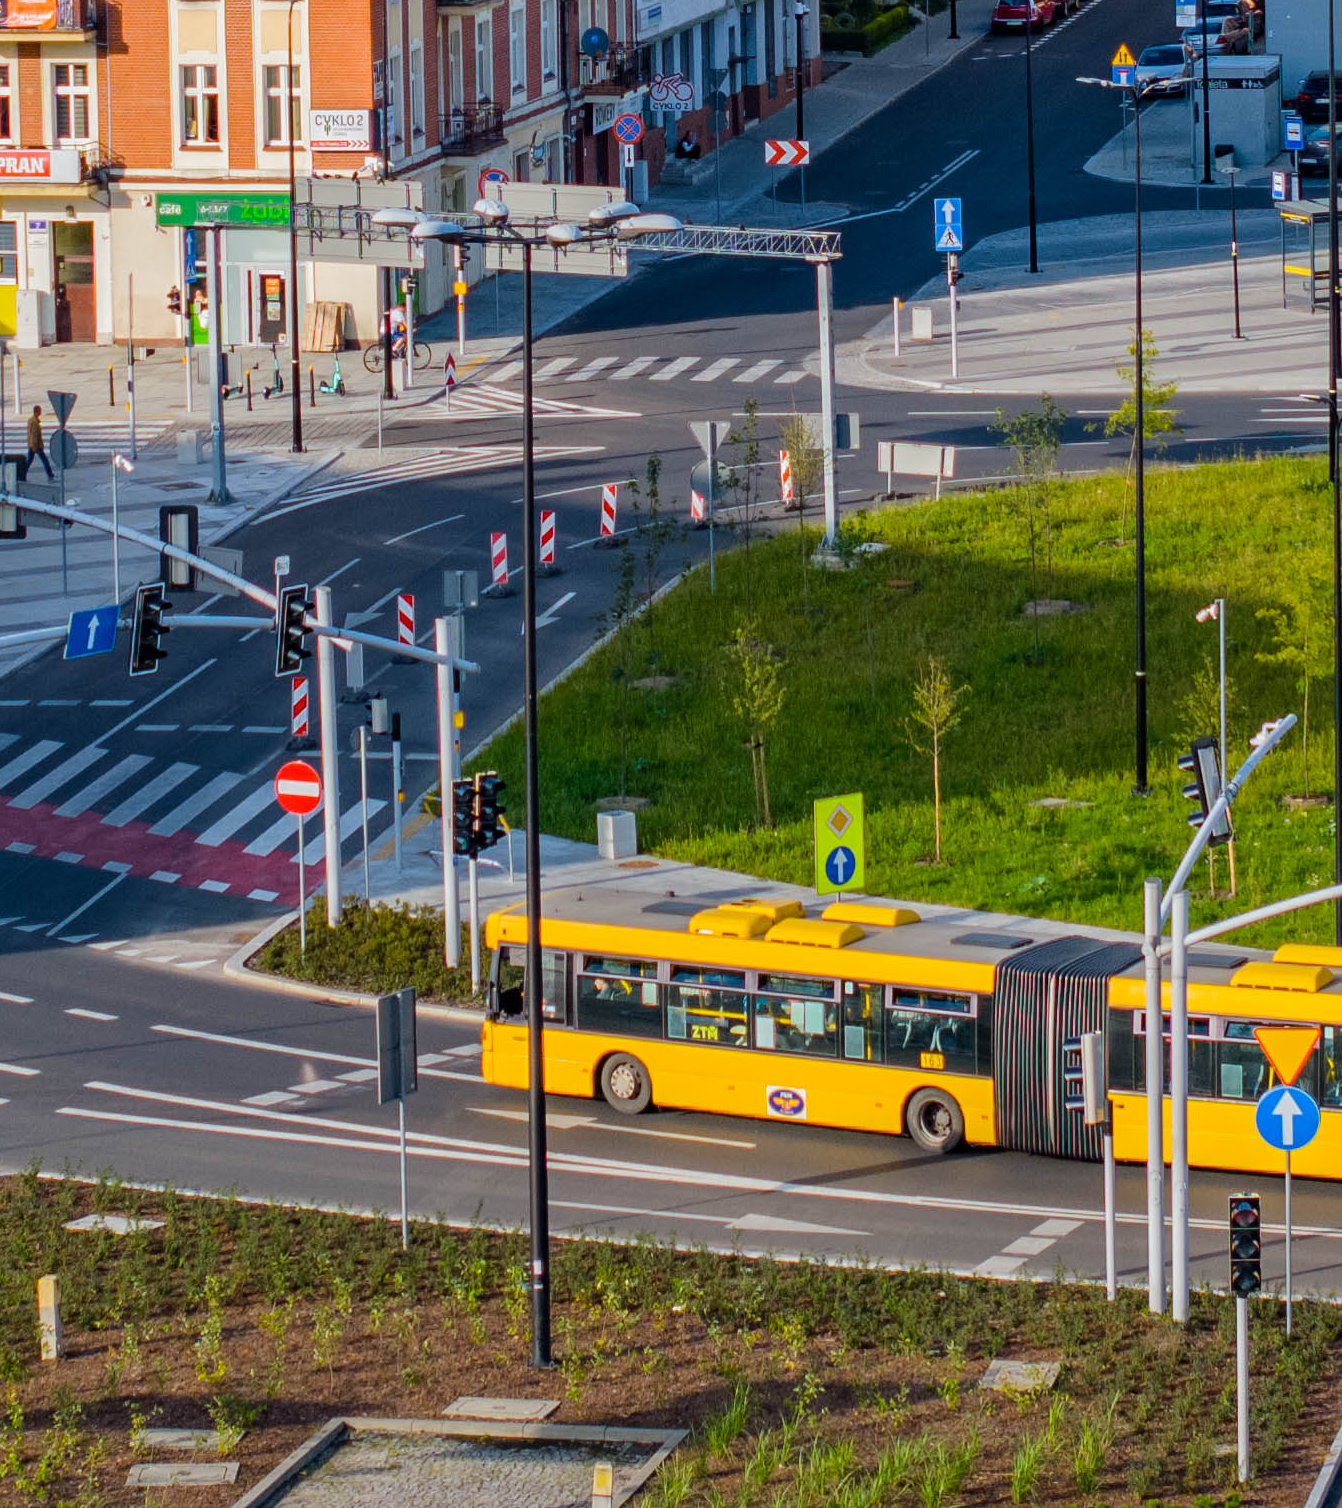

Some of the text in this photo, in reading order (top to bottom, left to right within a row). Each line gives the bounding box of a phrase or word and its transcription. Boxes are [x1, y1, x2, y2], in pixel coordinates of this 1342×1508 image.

[1196, 78, 1228, 89] Toleta
[315, 115, 364, 127] CYKLO 2
[692, 1025, 719, 1041] ZTM
